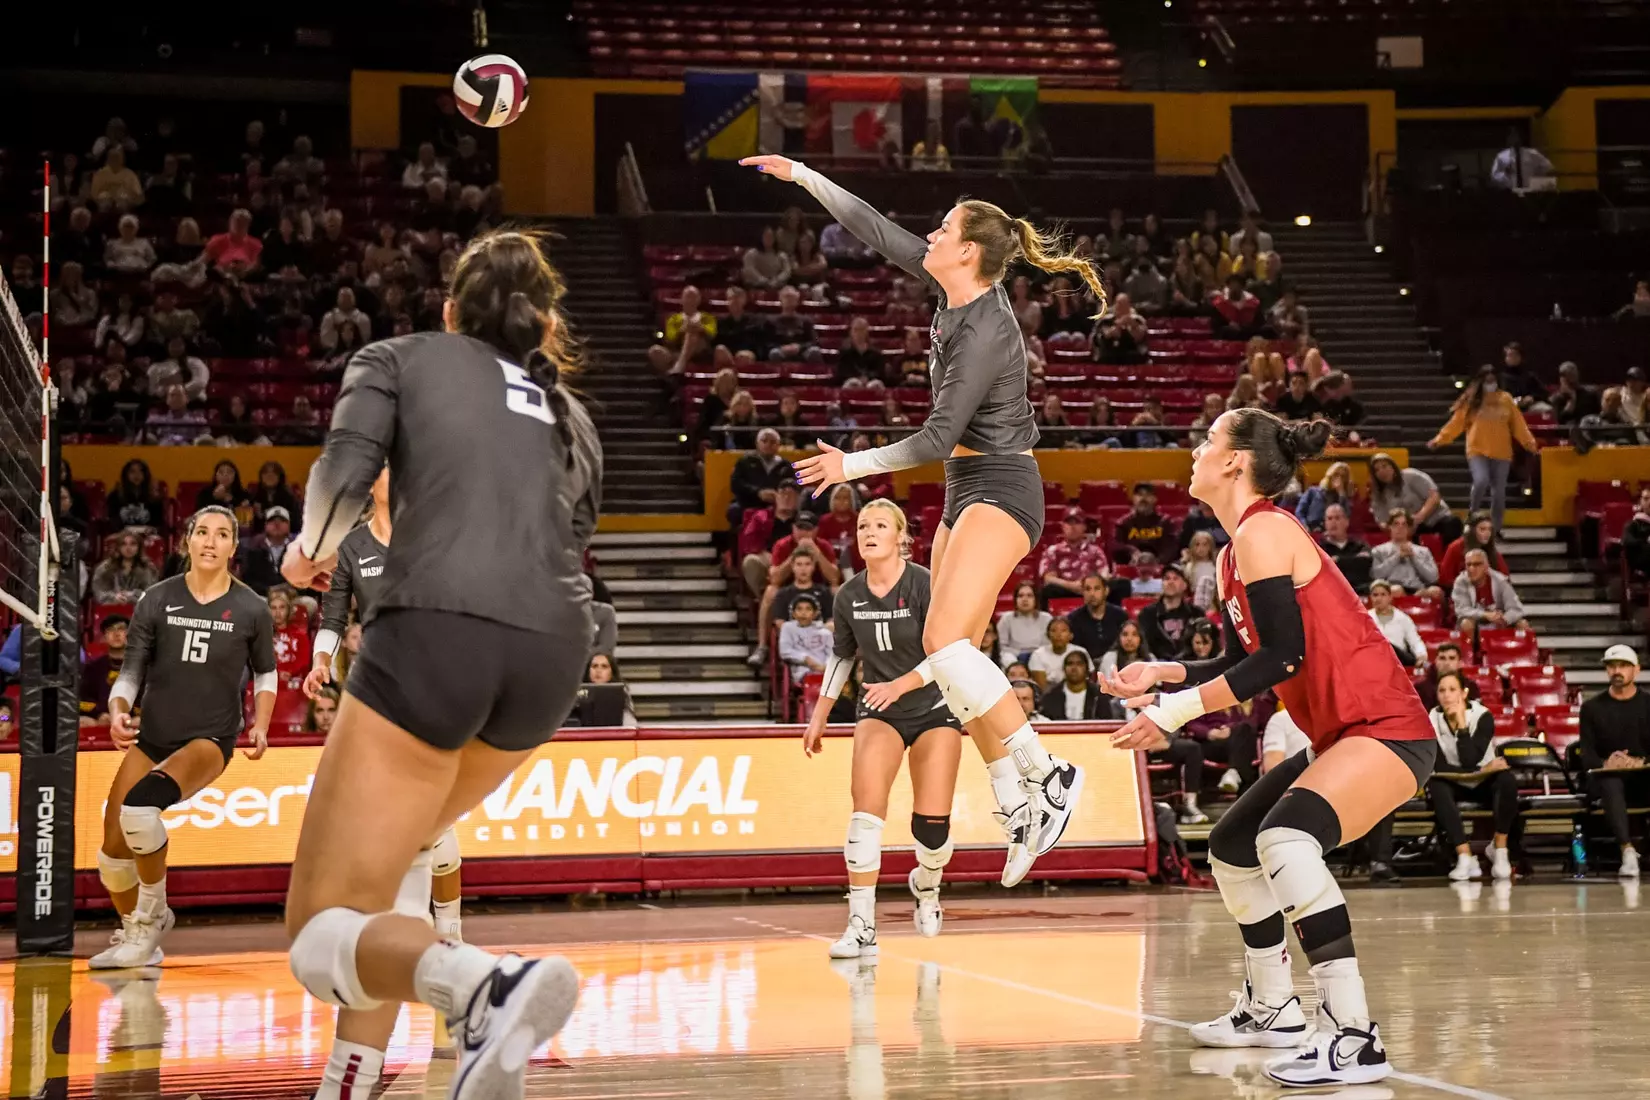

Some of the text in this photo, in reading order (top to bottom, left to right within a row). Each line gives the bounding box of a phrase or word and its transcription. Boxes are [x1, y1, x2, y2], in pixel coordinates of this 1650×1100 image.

[495, 358, 557, 425] 5
[167, 615, 235, 632] WASHINGTON STATE
[853, 608, 911, 620] WASHINGTON STATE
[181, 629, 211, 664] 15
[874, 621, 893, 651] 11
[475, 820, 755, 841] CREDIT UNION
